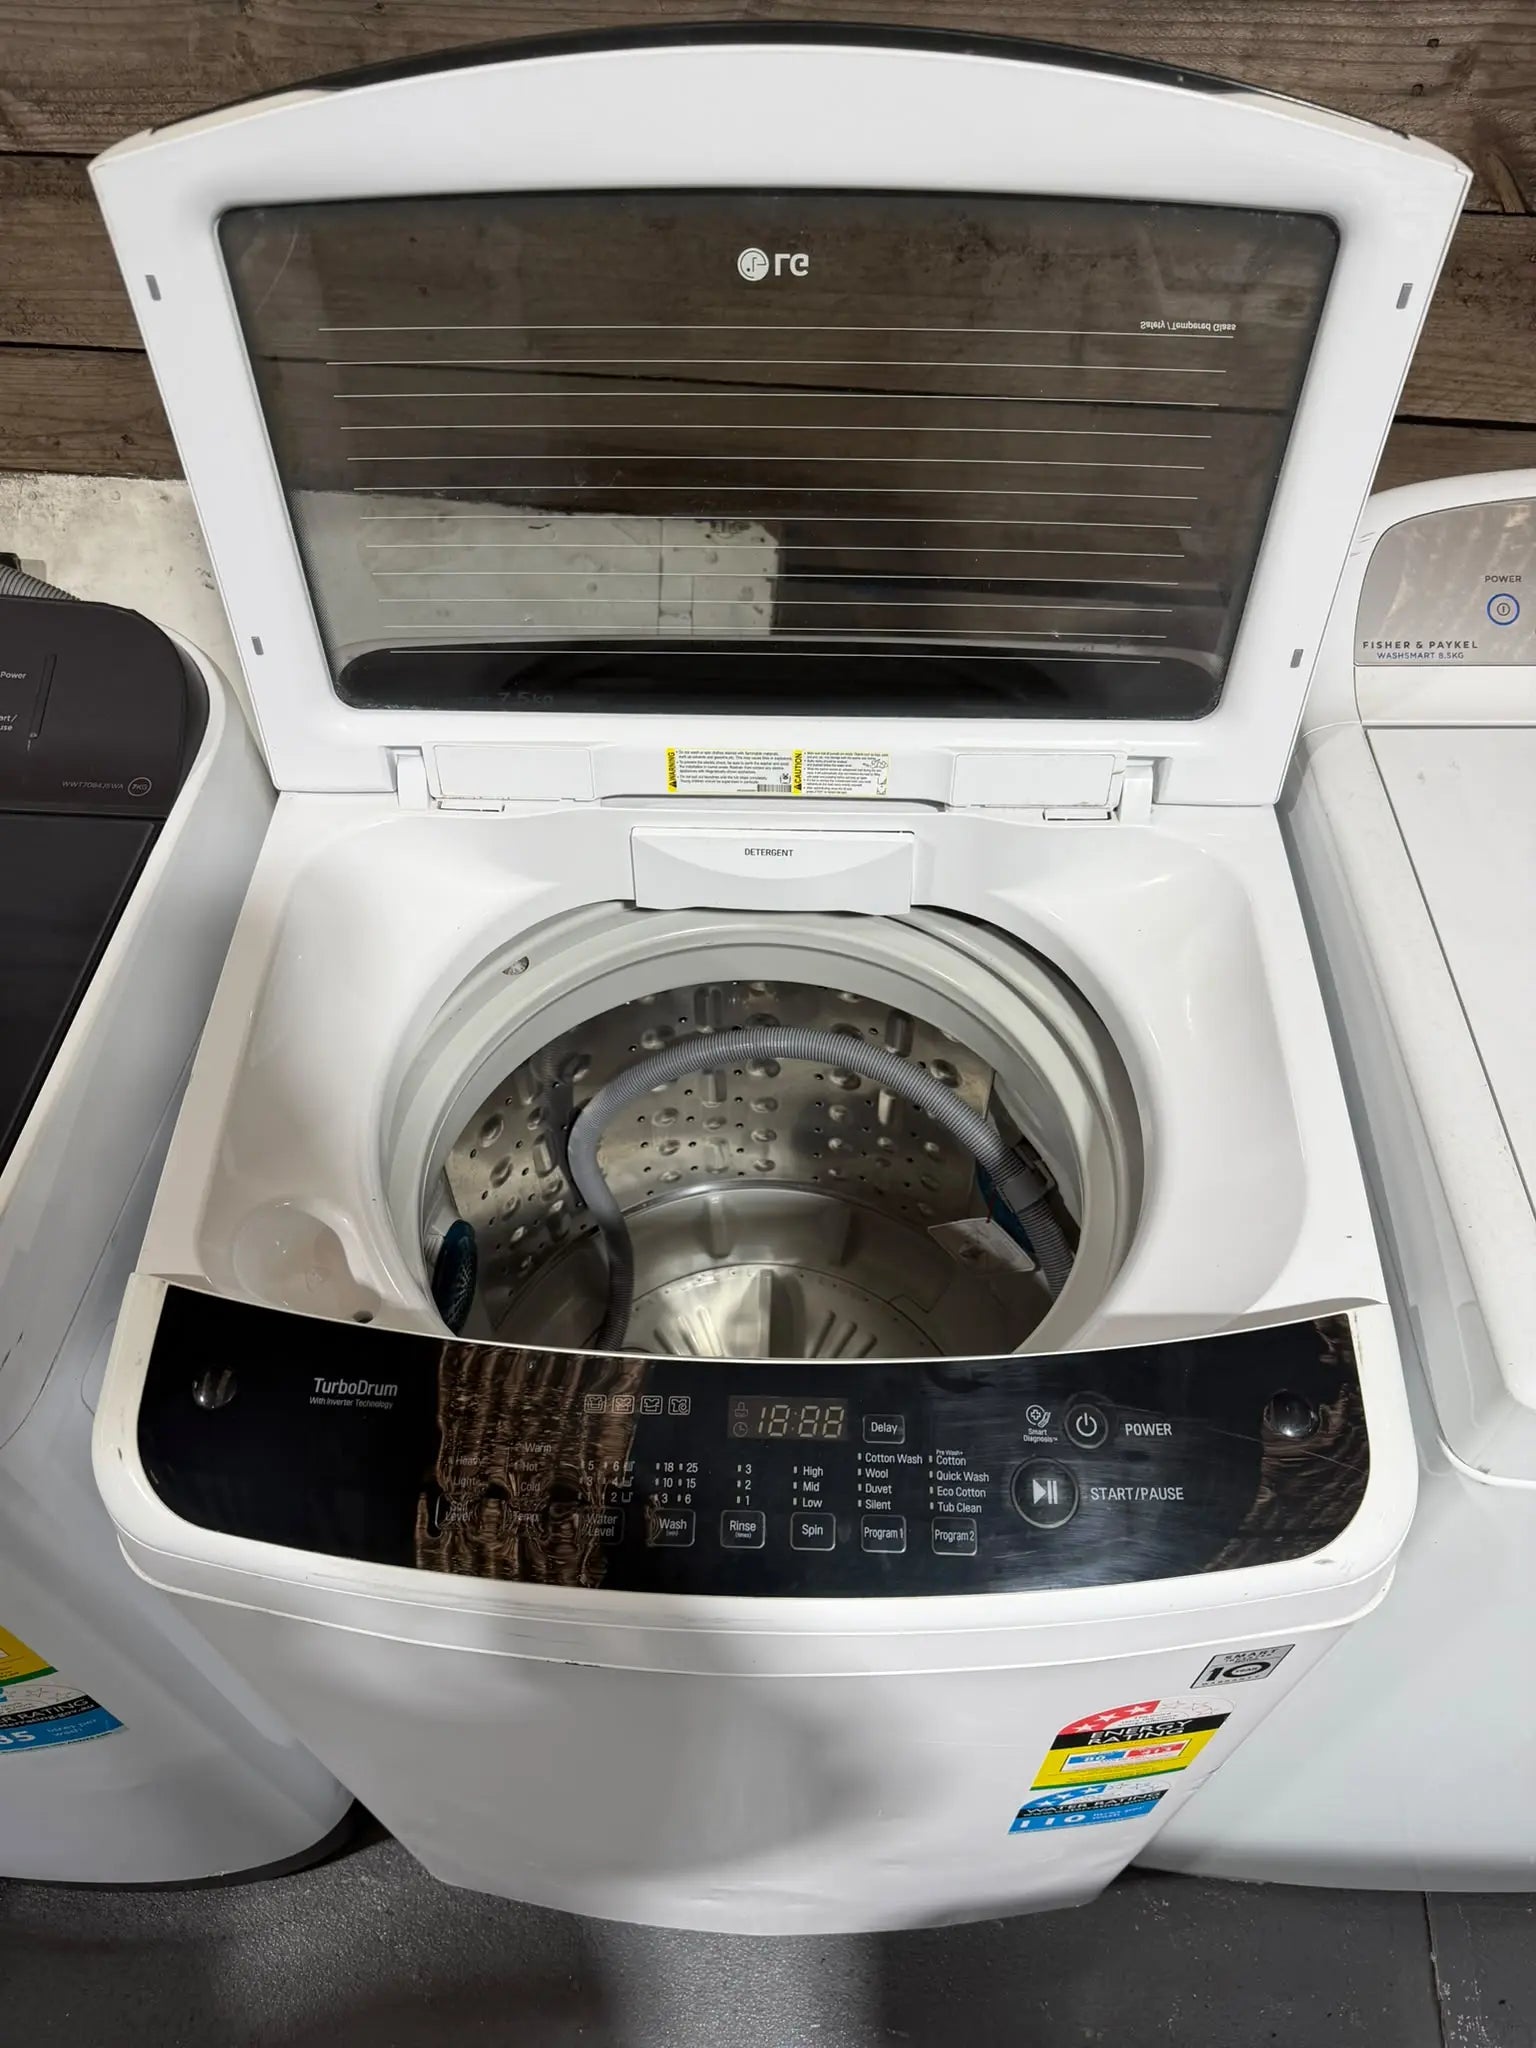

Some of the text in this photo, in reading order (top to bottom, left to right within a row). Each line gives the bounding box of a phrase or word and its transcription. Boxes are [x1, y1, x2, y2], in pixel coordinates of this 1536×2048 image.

[1484, 575, 1522, 583] POWER
[1362, 640, 1479, 649] FISHER & PAYKEL
[1438, 652, 1464, 660] 8.5KG
[0, 671, 27, 680] Power
[667, 751, 676, 781] WARNING
[794, 752, 802, 784] CAUTION
[744, 848, 794, 857] DETERGENT
[313, 1377, 398, 1396] TurboDrum
[309, 1396, 326, 1405] With
[355, 1399, 394, 1410] Technology
[870, 1422, 898, 1435] Delay
[1124, 1423, 1173, 1436] POWER
[524, 1442, 552, 1453] Warm
[865, 1452, 923, 1464] Cotton Wash
[936, 1456, 966, 1466] Cotton
[522, 1462, 538, 1471] Hot
[588, 1460, 620, 1471] 5 6
[664, 1462, 698, 1473] 18 25
[745, 1464, 752, 1474] 3
[803, 1466, 823, 1478] High
[865, 1468, 889, 1478] Wool
[936, 1471, 989, 1482] Quick Wash
[586, 1475, 618, 1486] 3 4
[663, 1477, 696, 1488] 10 15
[745, 1480, 751, 1490] 2
[520, 1481, 540, 1492] Cold
[803, 1481, 820, 1492] Mid
[865, 1484, 892, 1494] Duvet
[937, 1486, 986, 1498] Eco Cotton
[611, 1492, 617, 1502] 2
[661, 1494, 691, 1504] 3 6
[1090, 1487, 1184, 1501] START/PAUSE
[745, 1496, 750, 1505] 1
[802, 1498, 823, 1508] Low
[865, 1500, 891, 1510] Silent
[937, 1502, 982, 1513] Tub Clean
[586, 1514, 618, 1525] Water
[659, 1518, 687, 1530] Wash
[587, 1526, 615, 1537] Level
[729, 1520, 757, 1532] Rinse
[801, 1525, 823, 1537] Spin
[864, 1527, 904, 1540] Program 1
[935, 1529, 975, 1542] Program 2
[17, 1698, 90, 1720] RATING
[1090, 1720, 1193, 1739] ENERGY
[1088, 1728, 1185, 1745] RATING
[1026, 1803, 1090, 1814] WATER
[1094, 1791, 1162, 1806] RATING
